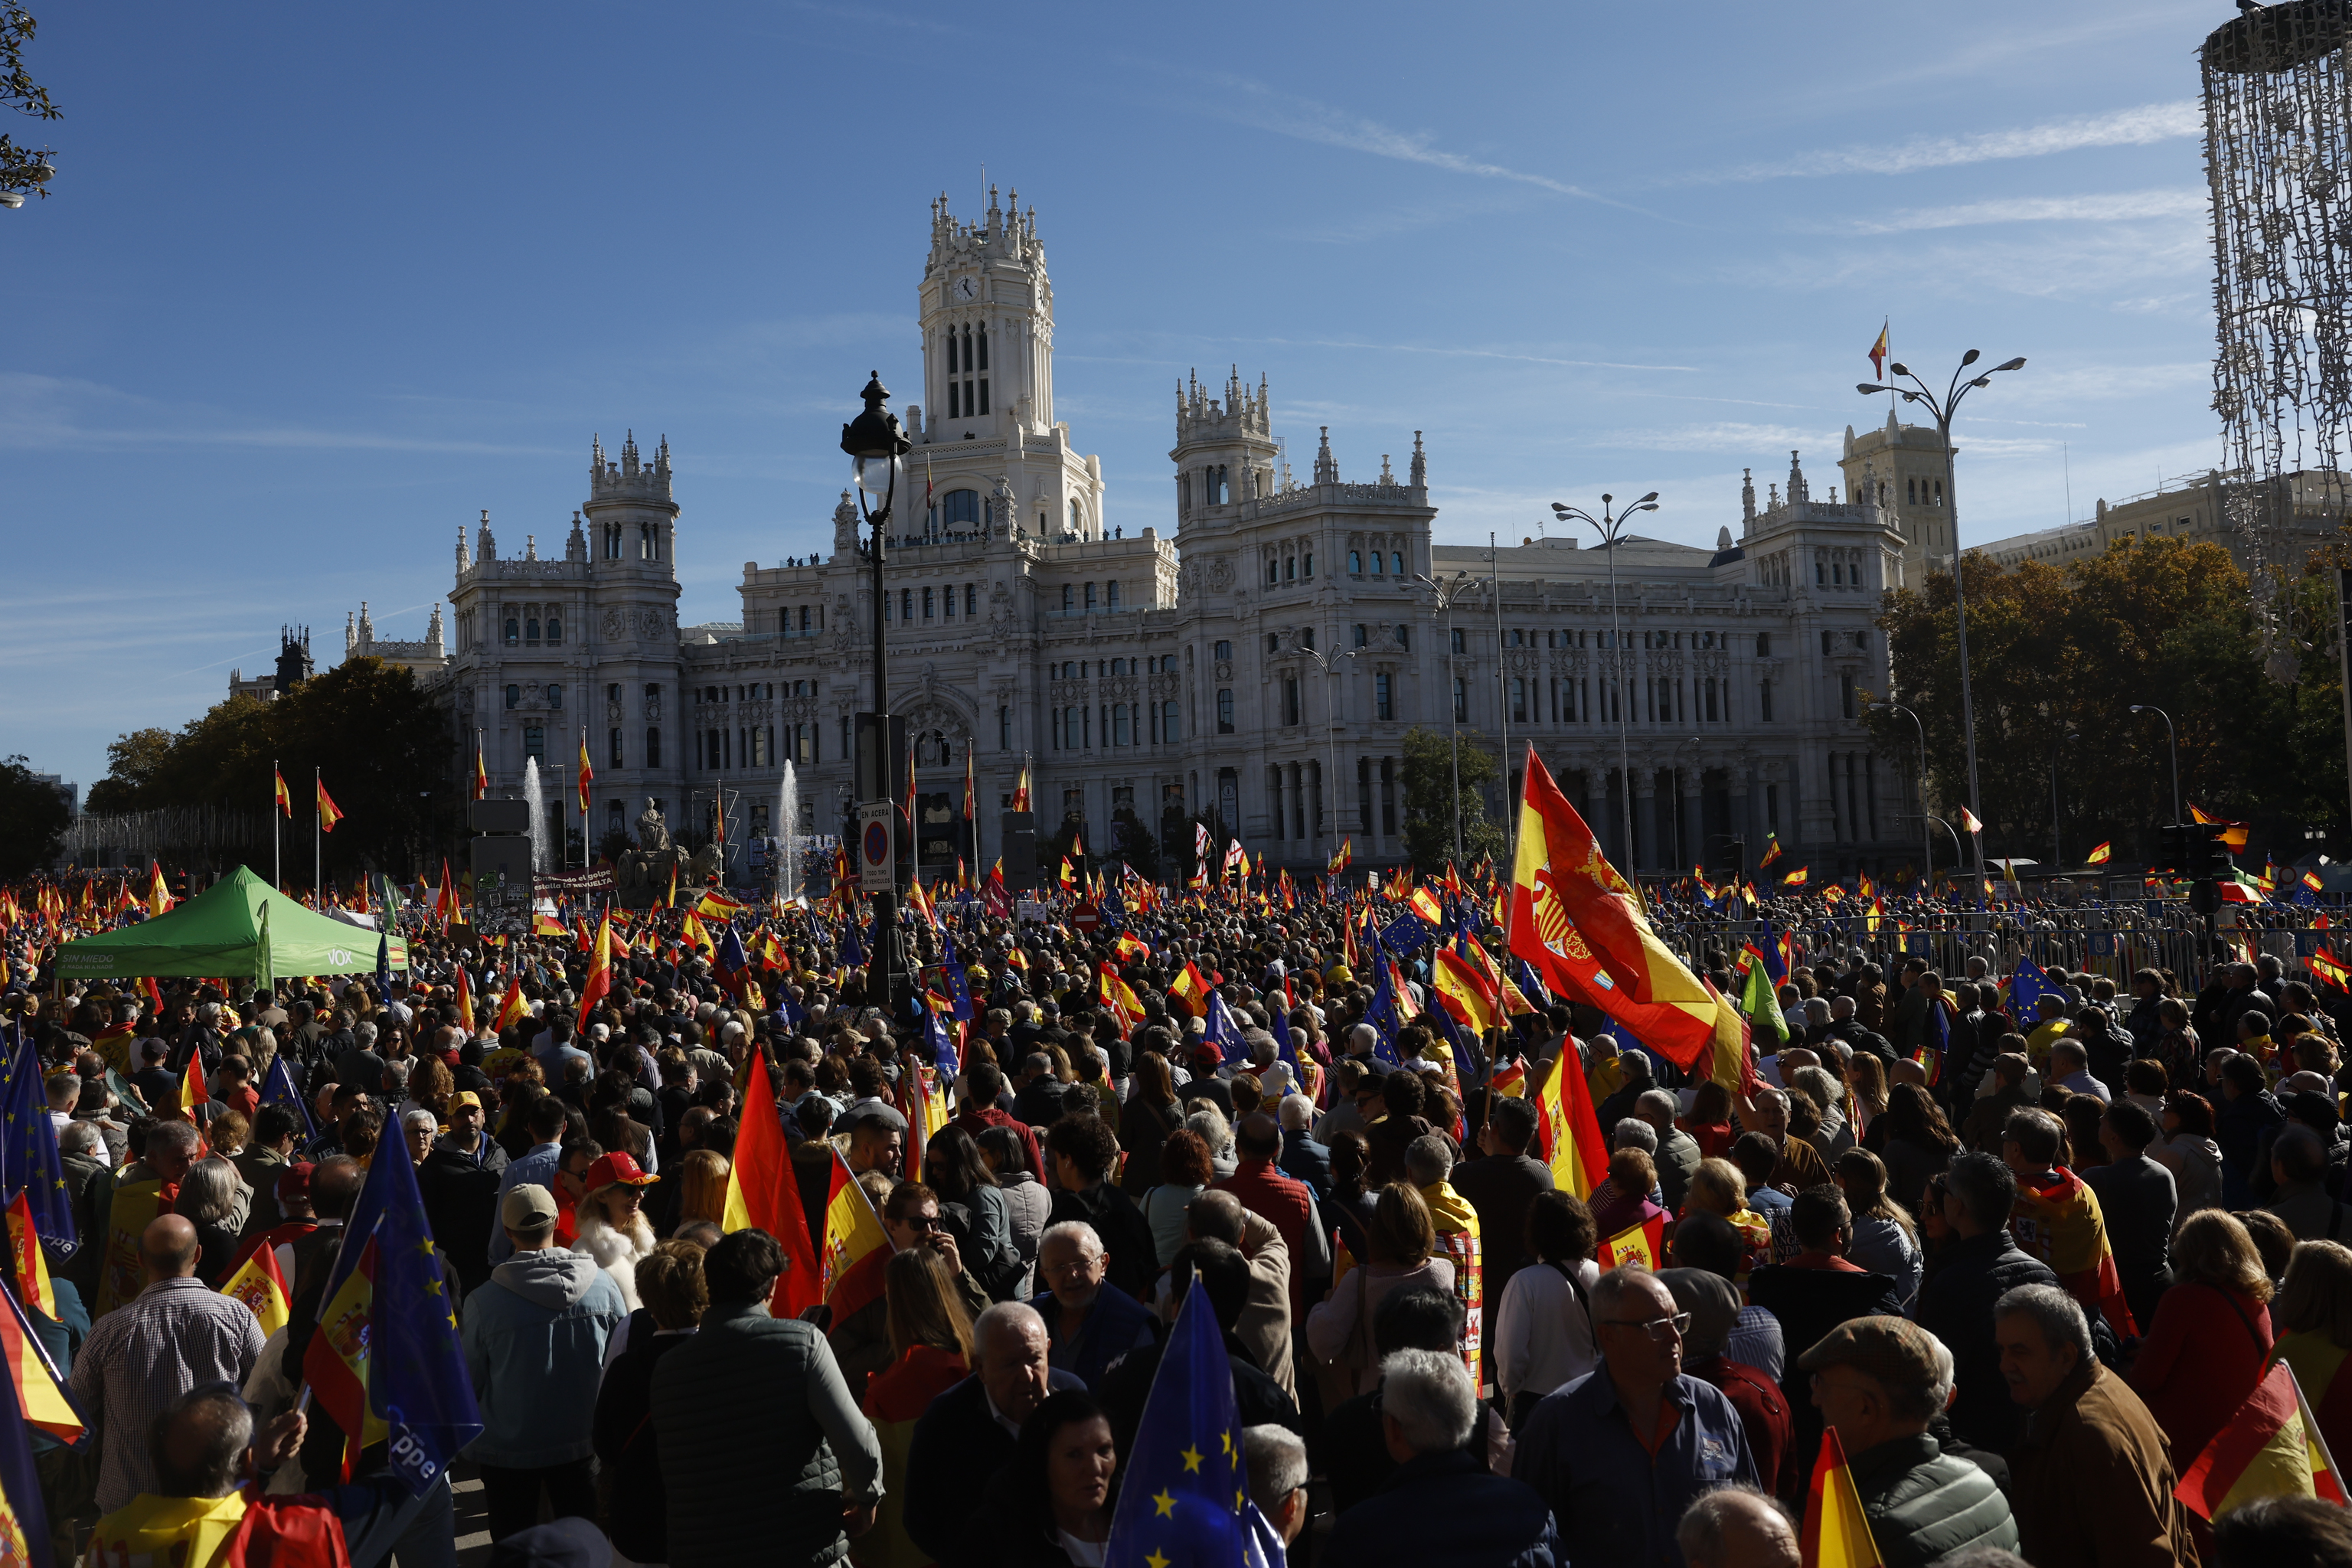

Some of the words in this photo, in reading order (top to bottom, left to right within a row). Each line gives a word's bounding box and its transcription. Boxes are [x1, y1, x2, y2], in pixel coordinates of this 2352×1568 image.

[861, 811, 869, 819] EN
[871, 808, 889, 818] ACERA
[588, 869, 611, 880] golpe
[534, 882, 561, 890] estalla
[572, 877, 613, 888] REVUELTA
[62, 954, 80, 963] SIN
[80, 954, 114, 963] MIEDO
[328, 948, 353, 966] VOX
[1765, 1207, 1792, 1218] SEOU
[1766, 1217, 1793, 1228] TOKY
[390, 1435, 436, 1479] ppe
